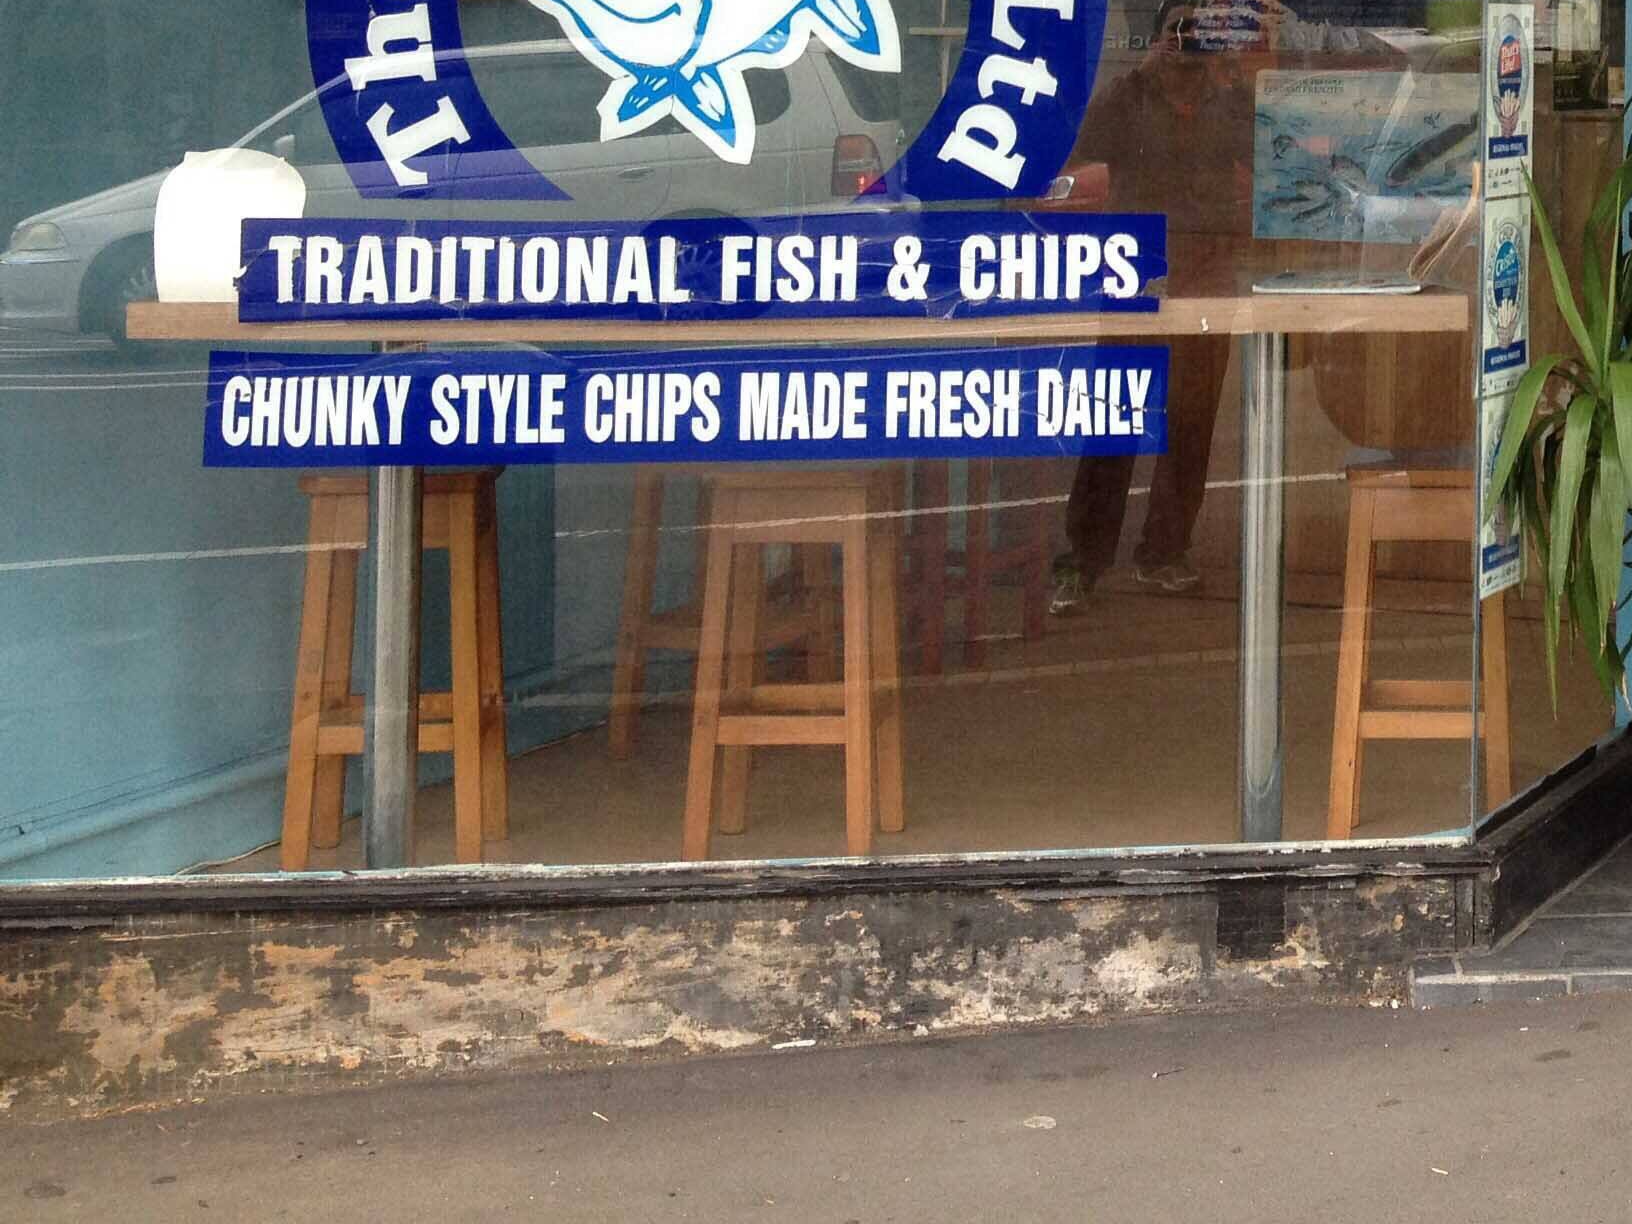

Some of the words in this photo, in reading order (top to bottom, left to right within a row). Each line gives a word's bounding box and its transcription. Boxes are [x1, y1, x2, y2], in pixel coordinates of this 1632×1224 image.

[268, 234, 690, 306] TRADITIONAL
[721, 235, 859, 303] FISH
[887, 240, 929, 302] &
[958, 233, 1140, 302] CHIPS
[221, 374, 408, 447] CHUNKY
[430, 374, 565, 445] STYLE
[584, 373, 720, 443] CHIPS
[739, 371, 867, 440] MADE
[885, 369, 1020, 439] FRESH
[1036, 367, 1152, 437] DAILY
